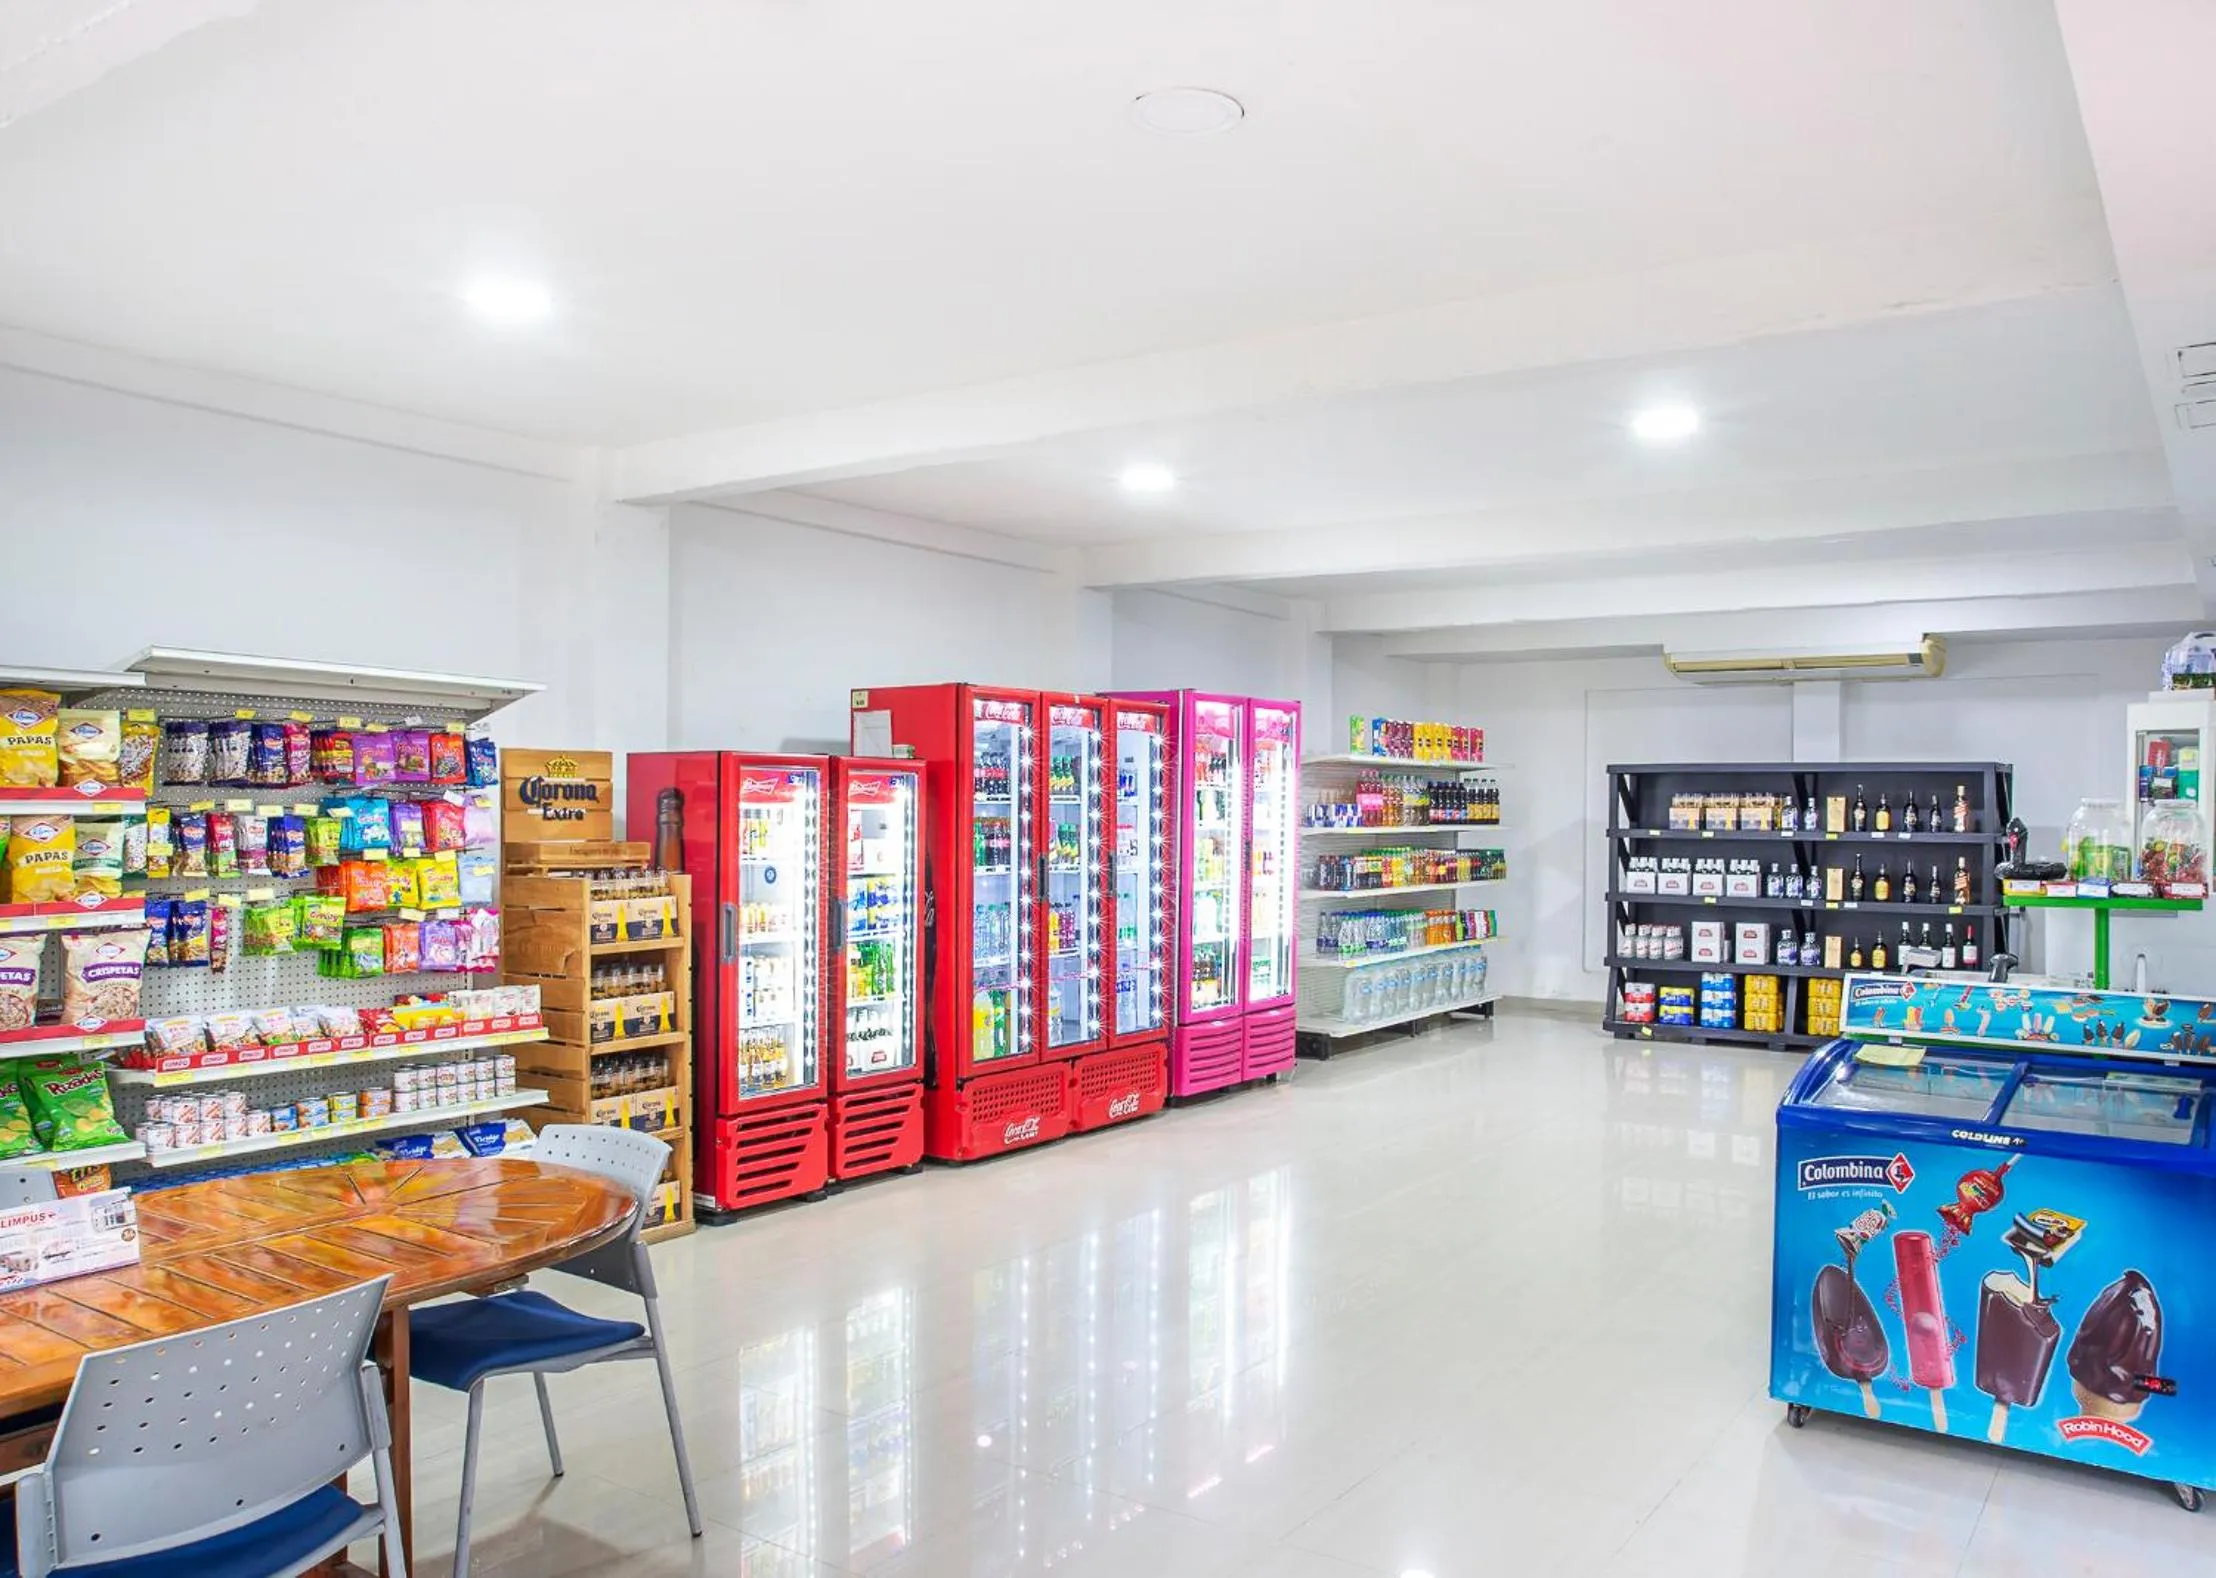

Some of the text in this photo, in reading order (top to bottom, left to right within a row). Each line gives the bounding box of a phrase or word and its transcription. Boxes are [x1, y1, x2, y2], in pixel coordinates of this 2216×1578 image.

[7, 736, 52, 746] PAPAS
[519, 776, 600, 807] Corona
[542, 802, 584, 821] Extra
[25, 851, 69, 864] PAPAS
[87, 965, 140, 978] CRISPETAS
[1804, 1160, 1884, 1181] Colombina
[1817, 1190, 1839, 1199] sabor
[1852, 1188, 1883, 1199] infinito
[2063, 1421, 2145, 1448] Robin Hood
